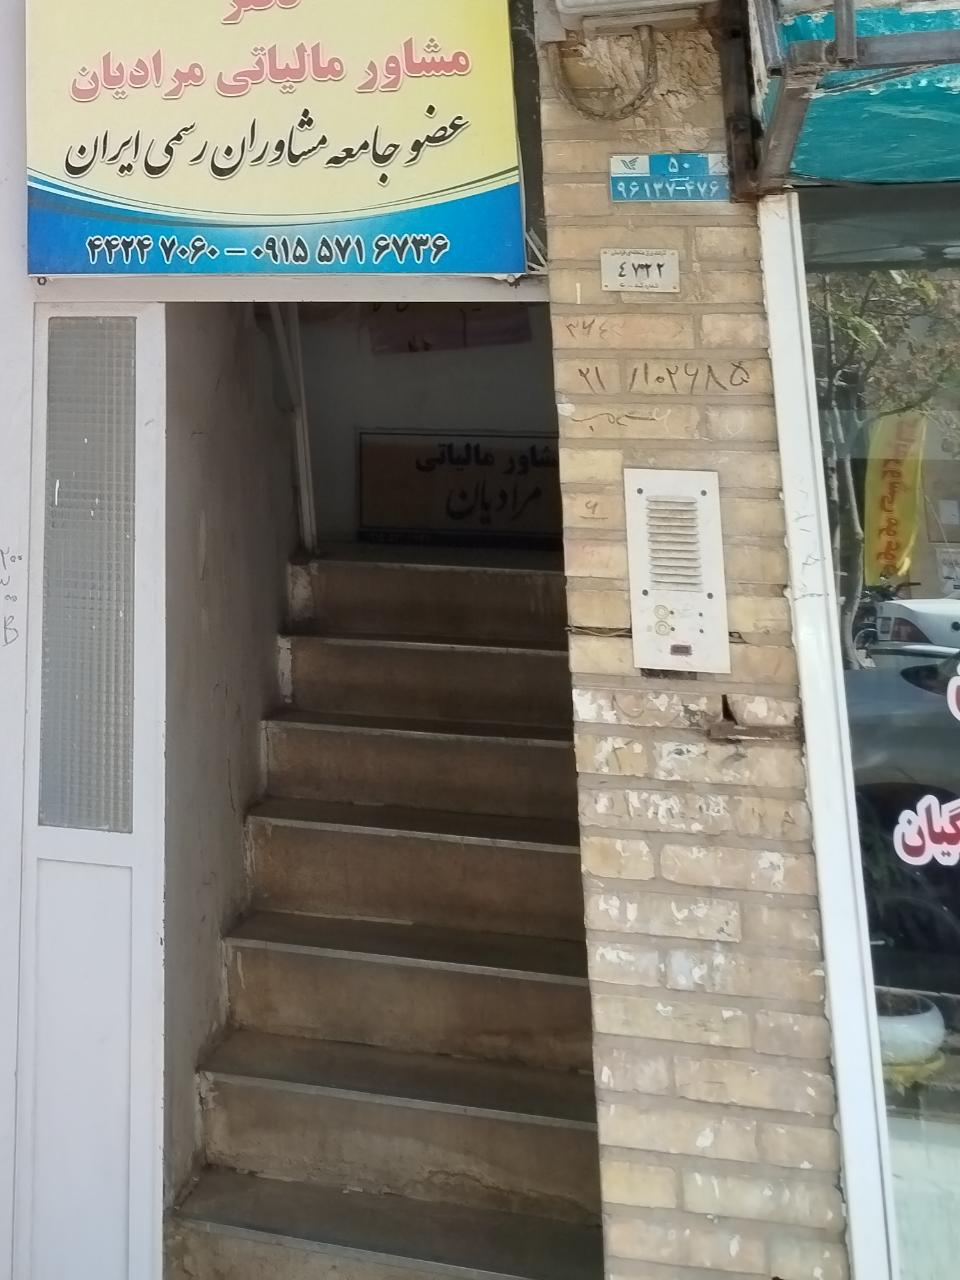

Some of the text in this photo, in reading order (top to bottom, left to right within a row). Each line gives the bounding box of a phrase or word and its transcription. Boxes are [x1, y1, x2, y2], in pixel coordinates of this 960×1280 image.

[70, 36, 472, 103] مشاور مالیاتی مرادیان
[63, 104, 472, 187] عضو جامعه مشاوران رسمی ایران
[85, 234, 154, 265] ۴۴۲۴
[158, 234, 220, 265] ۷۰۶۰
[251, 234, 310, 264] ۰۹۱۵
[315, 234, 365, 264] ۵۷۱
[372, 233, 451, 264] ۶۷۳۶
[415, 441, 558, 475] شاور مالیاتی
[445, 478, 544, 525] مرادیان
